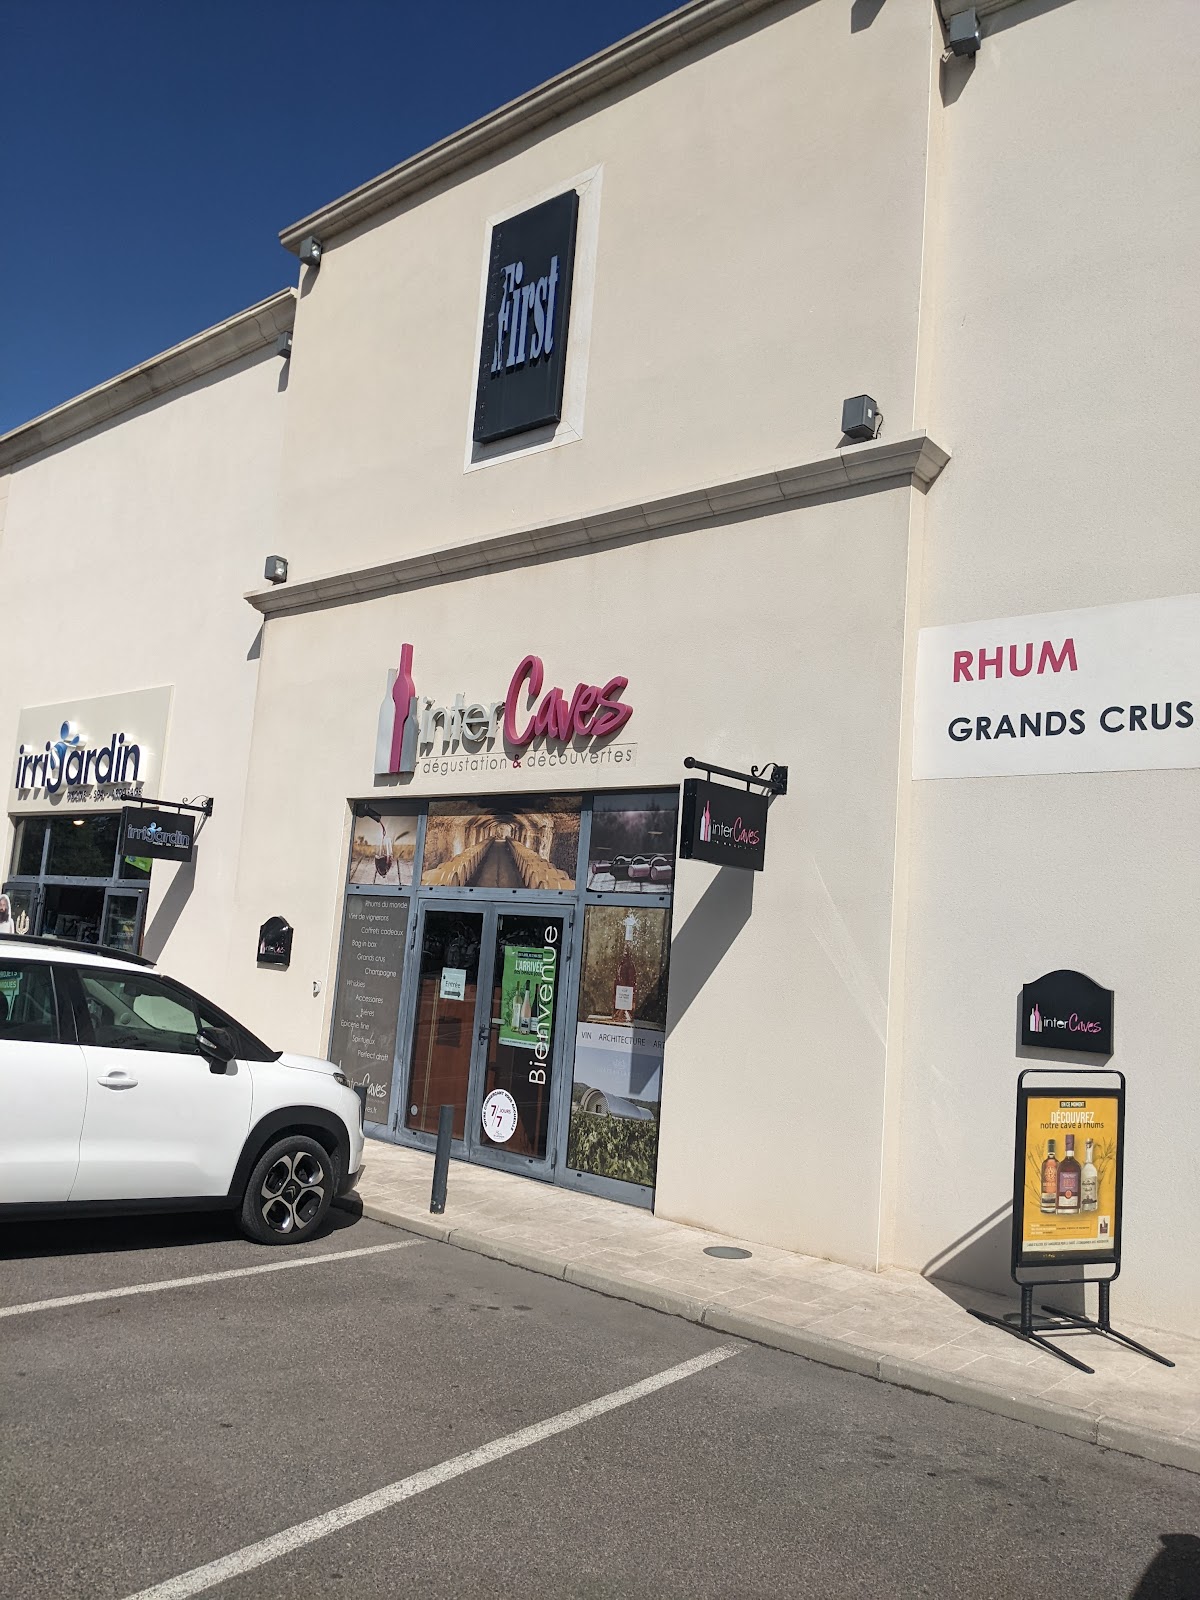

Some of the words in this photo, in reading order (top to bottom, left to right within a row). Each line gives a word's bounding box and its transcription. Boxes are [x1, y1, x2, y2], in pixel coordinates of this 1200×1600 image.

[491, 255, 558, 373] First
[953, 638, 1078, 682] RHUM
[948, 708, 1086, 741] GRANDS
[1099, 701, 1194, 733] CRUS
[423, 756, 507, 776] dégustation
[512, 754, 522, 768] &
[527, 748, 632, 767] découvertes
[365, 900, 380, 908] Rhums
[351, 939, 362, 949] Bag
[368, 940, 377, 948] box
[356, 952, 375, 962] Grands
[375, 955, 386, 963] crus
[364, 967, 397, 978] Champagne
[355, 994, 383, 1004] Accessoires
[529, 925, 558, 1085] Bienvenue
[582, 1031, 592, 1039] VIN
[598, 1033, 646, 1047] ARCHITECTURE
[1051, 1110, 1095, 1124] DÉCOUVREZ
[1040, 1121, 1059, 1129] notre
[1060, 1121, 1076, 1129] cave
[1083, 1120, 1104, 1129] rhums
